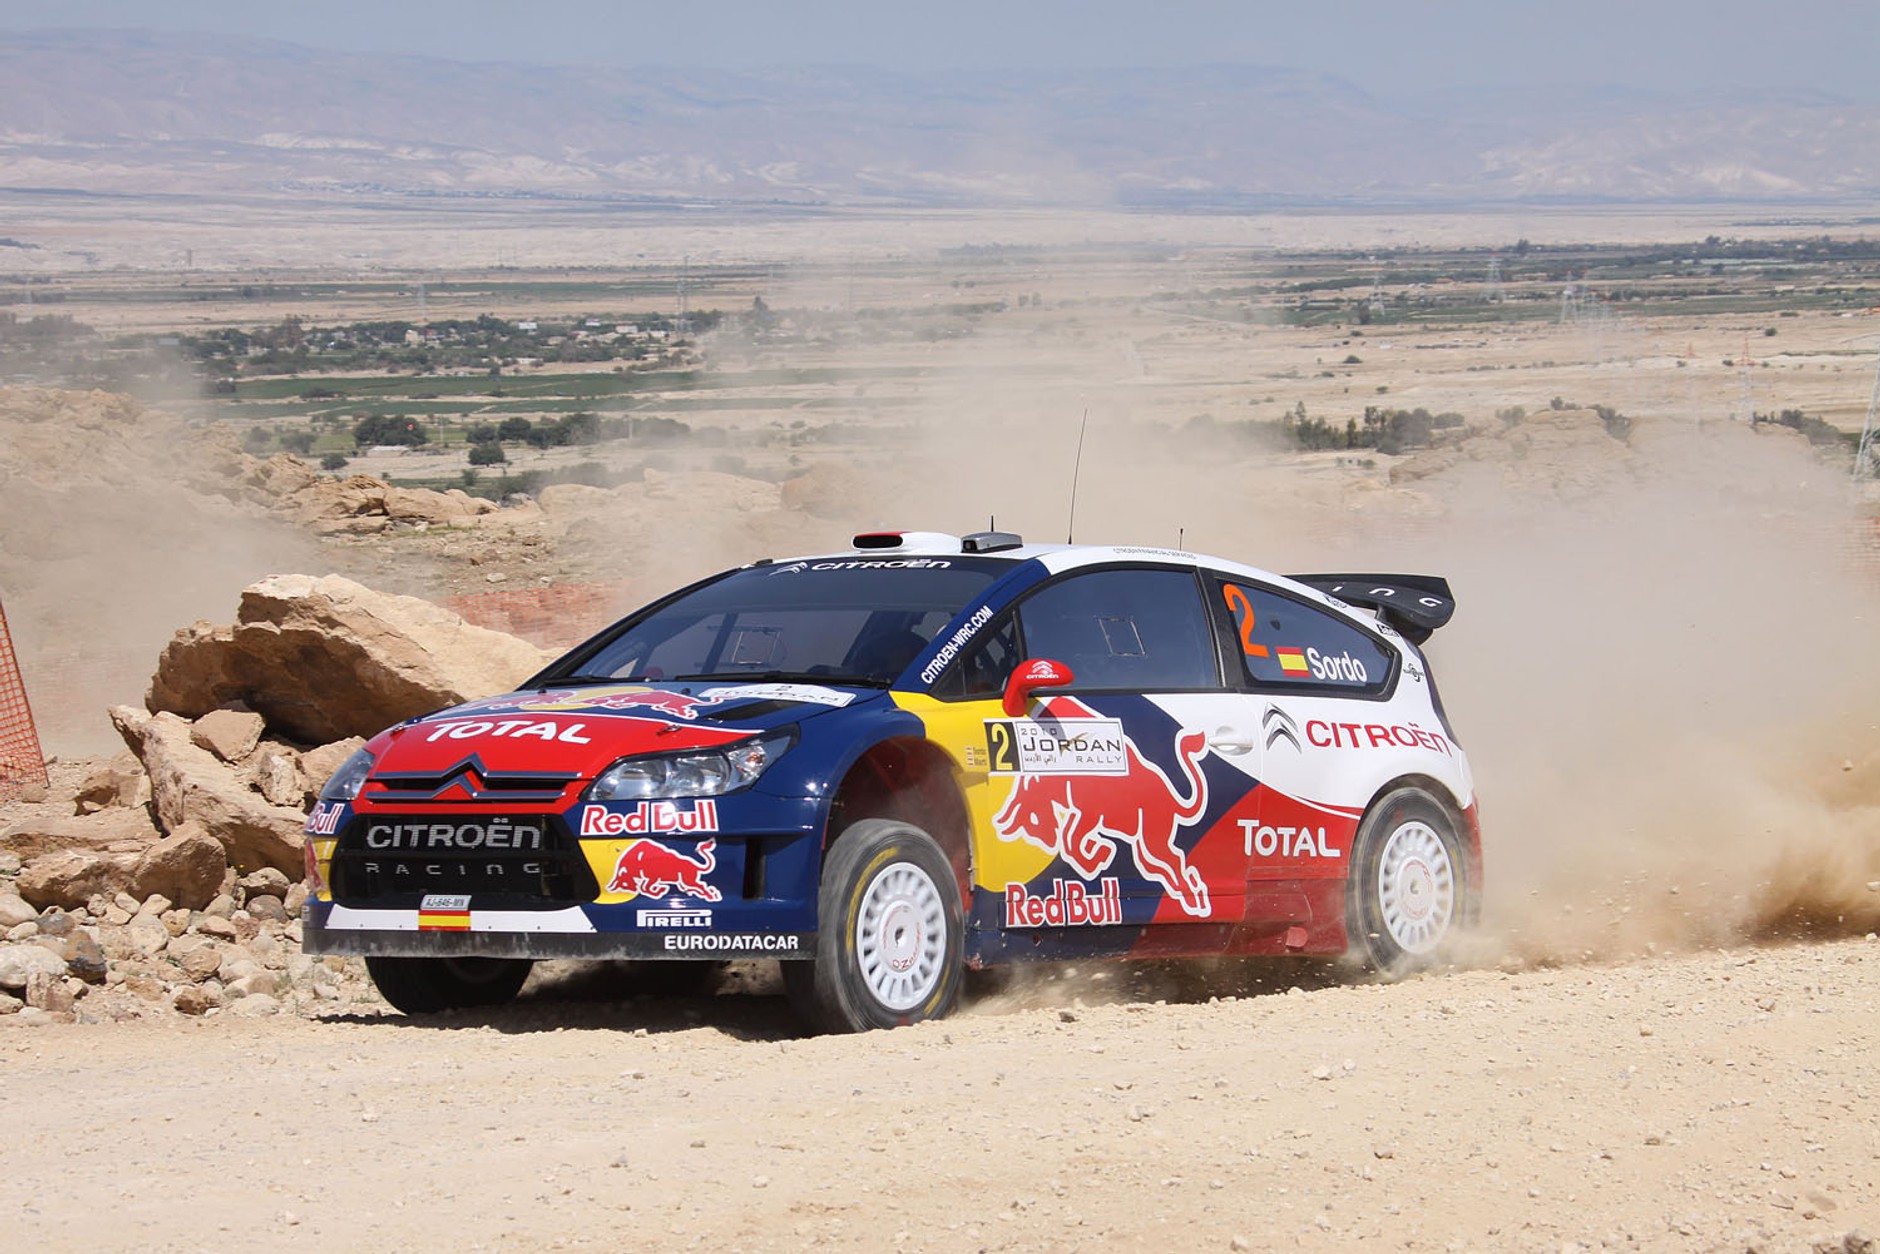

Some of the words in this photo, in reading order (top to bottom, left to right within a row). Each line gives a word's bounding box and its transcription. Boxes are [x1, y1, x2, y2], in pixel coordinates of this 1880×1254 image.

[1223, 583, 1270, 658] 2
[921, 605, 994, 684] CITROEN-WRC.COM
[1306, 647, 1368, 683] Sordo
[426, 720, 592, 744] TOTAL
[992, 722, 1014, 772] 2
[1020, 728, 1058, 736] 2010
[1022, 736, 1121, 752] JORDAN
[1306, 720, 1453, 758] CITROËN
[366, 817, 541, 849] CITROËN
[580, 801, 649, 836] Red
[650, 799, 720, 833] Bull
[1237, 819, 1341, 858] TOTAL
[636, 909, 712, 927] PIRELLI
[1005, 878, 1064, 928] Red
[1064, 876, 1123, 926] Bull
[664, 935, 799, 950] EURODATACAR
